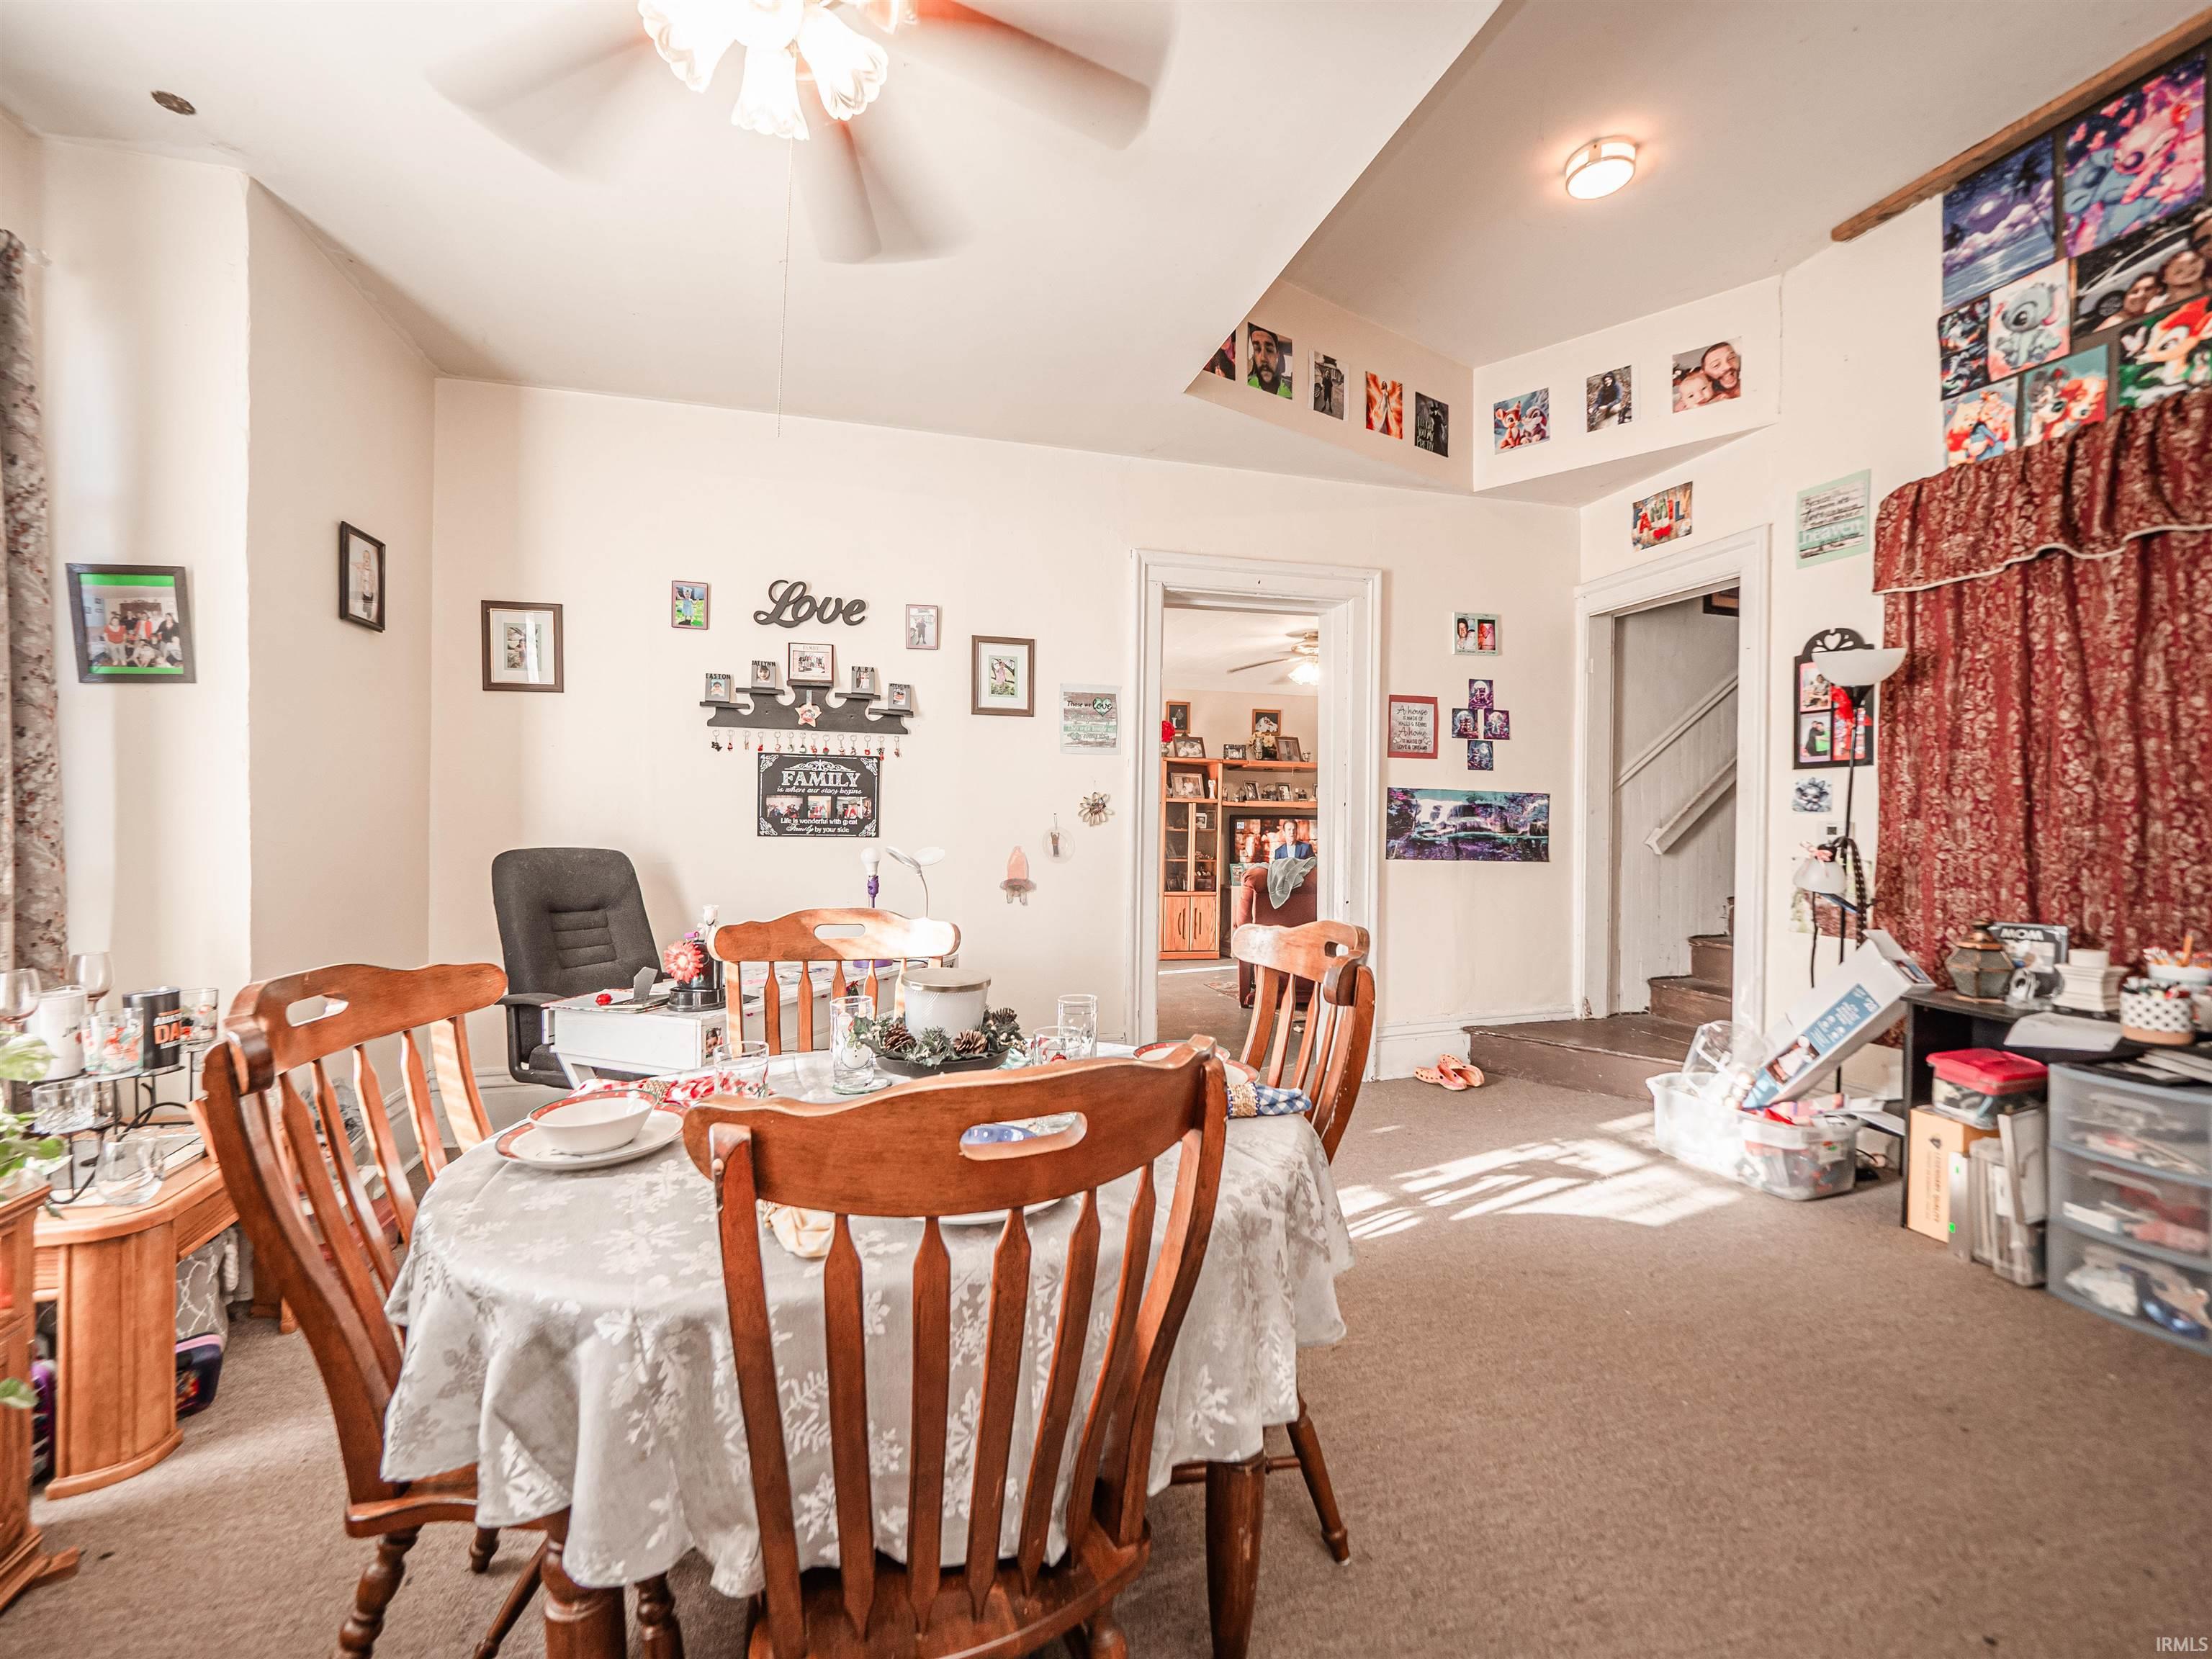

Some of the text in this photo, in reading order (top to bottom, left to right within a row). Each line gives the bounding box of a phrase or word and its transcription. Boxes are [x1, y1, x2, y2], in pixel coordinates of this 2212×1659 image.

[1632, 490, 1691, 534] FAMILY
[754, 580, 866, 629] Love
[1093, 698, 1112, 710] love
[1397, 706, 1406, 715] A
[1398, 727, 1408, 737] A
[781, 770, 861, 788] FAMILY
[840, 787, 863, 796] begins
[786, 823, 814, 835] Family
[2000, 928, 2044, 941] MOM
